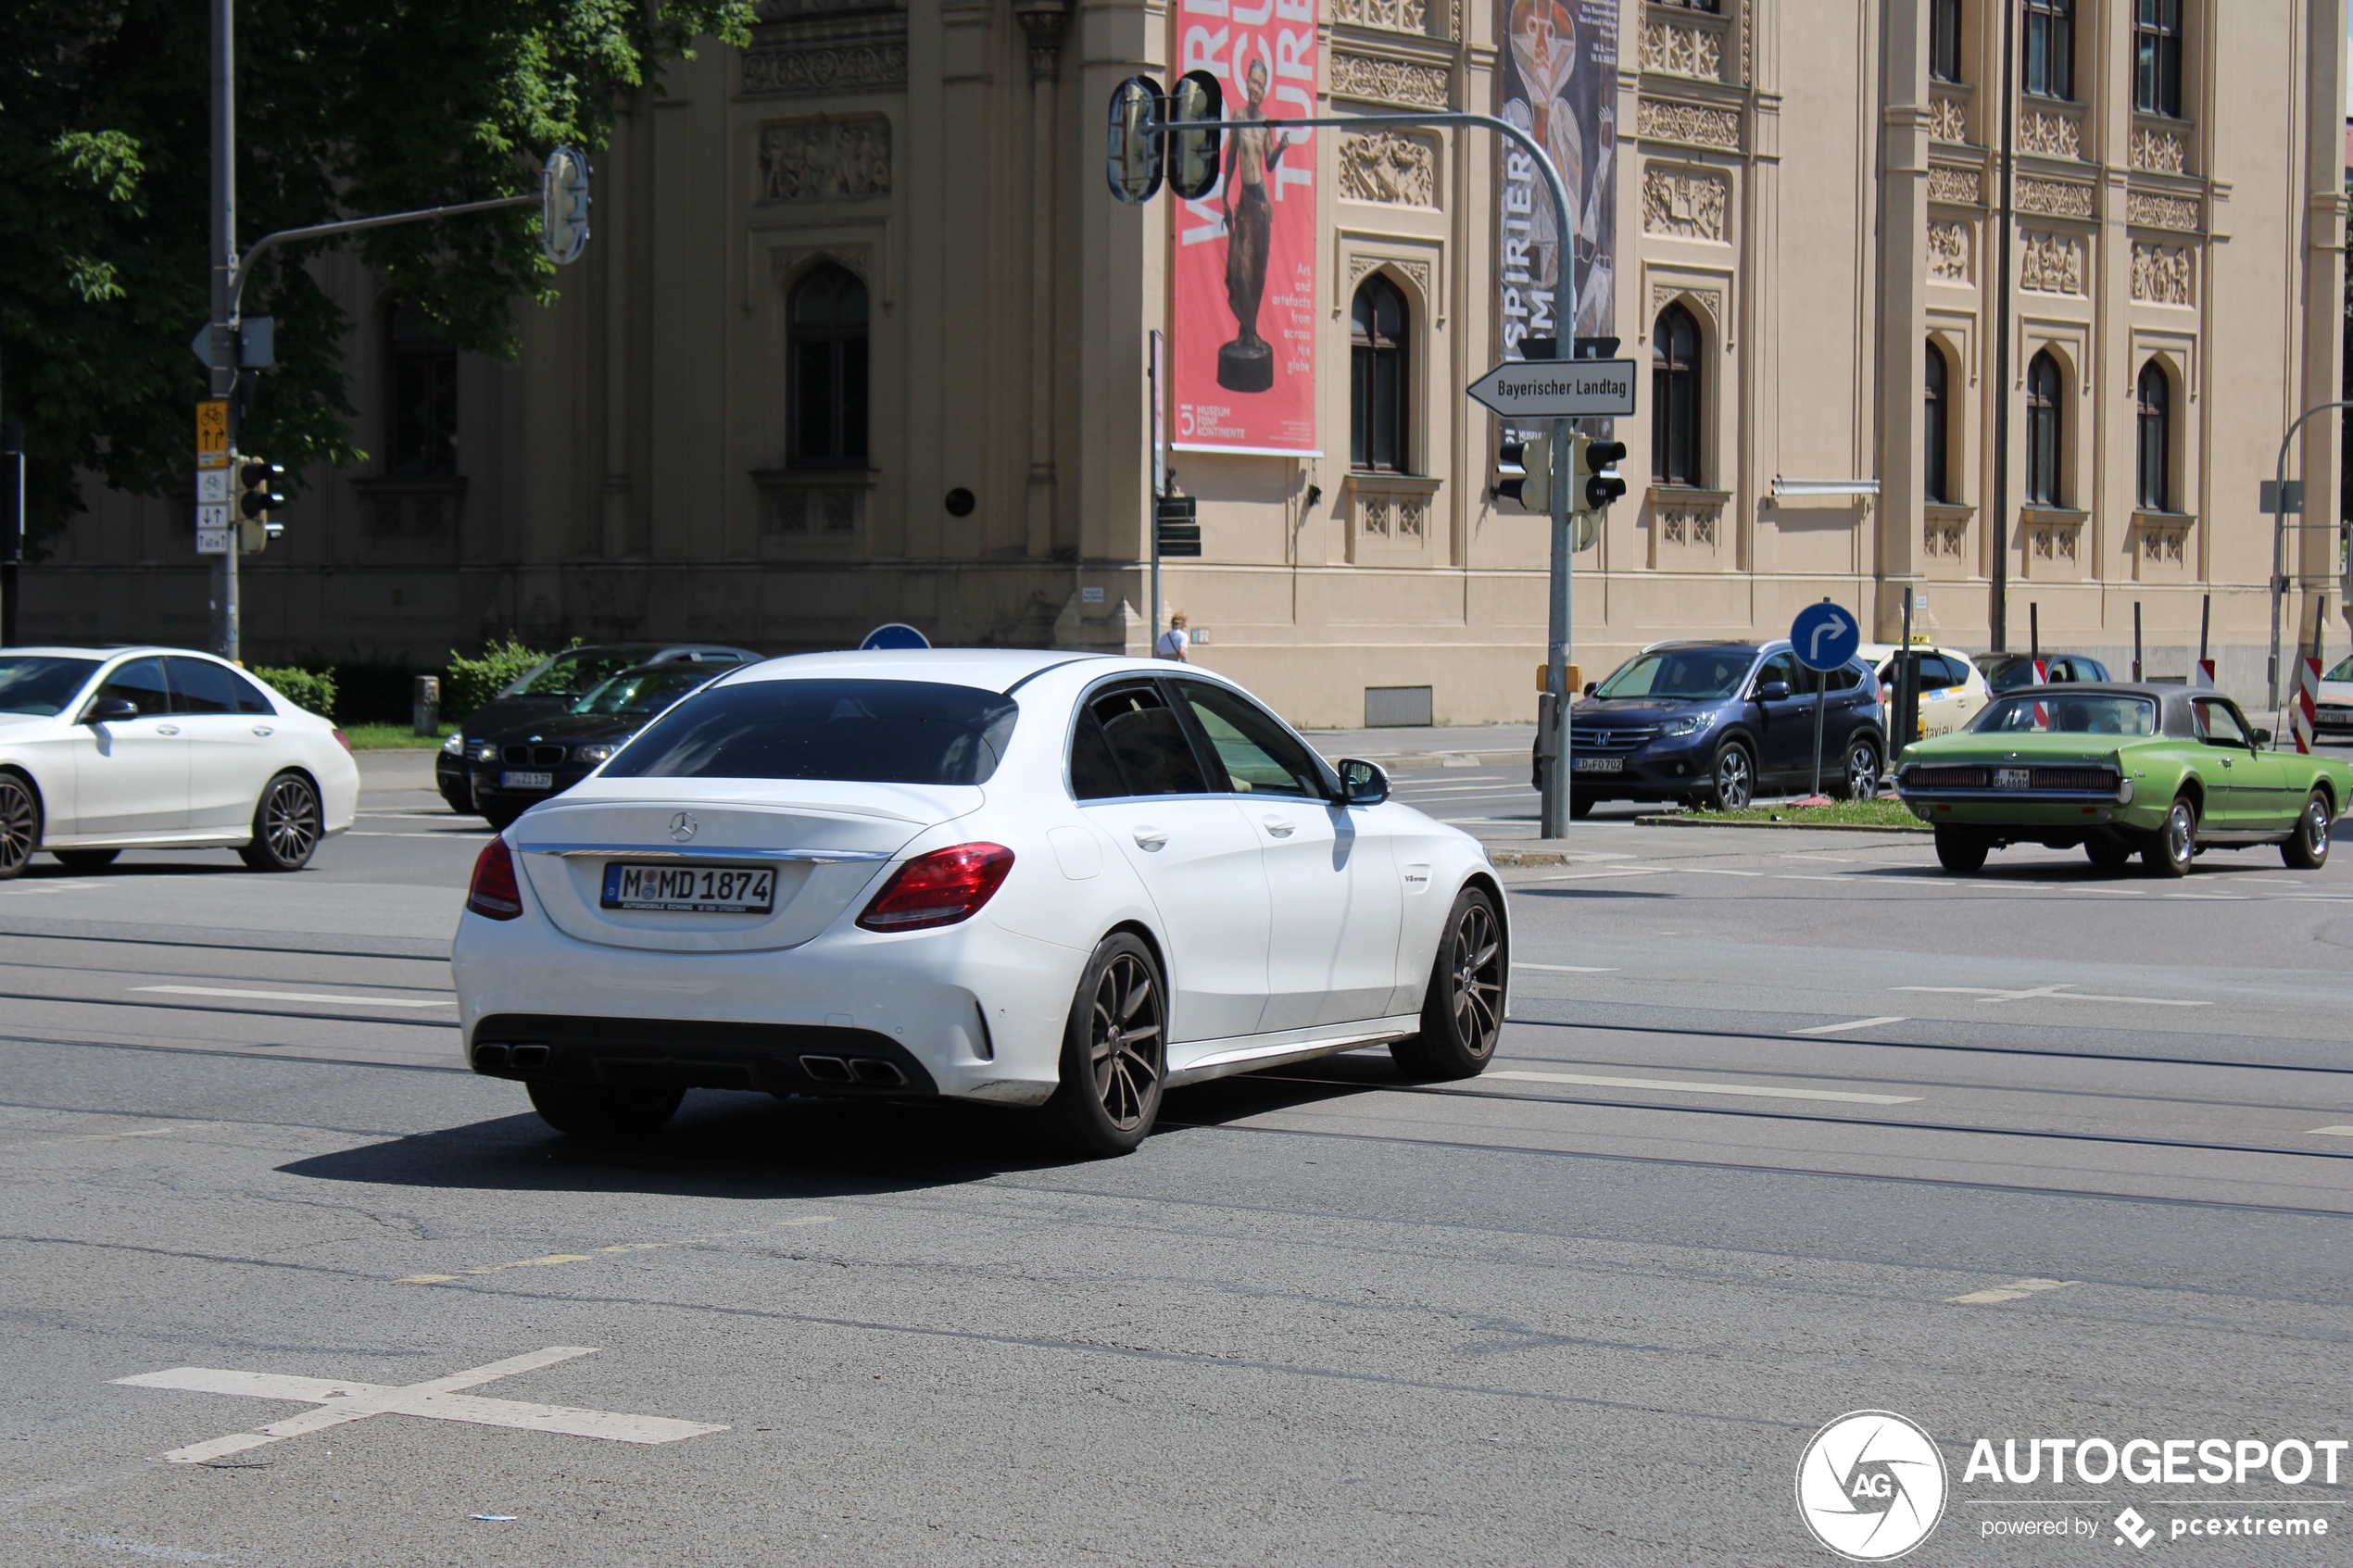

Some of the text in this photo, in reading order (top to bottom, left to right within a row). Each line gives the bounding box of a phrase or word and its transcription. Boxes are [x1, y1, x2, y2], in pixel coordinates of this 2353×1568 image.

[1297, 262, 1311, 276] Art
[1295, 280, 1311, 293] and
[1272, 293, 1311, 308] artefacts
[1290, 310, 1311, 324] from
[1283, 328, 1311, 341] across
[1297, 343, 1311, 357] the
[1287, 358, 1310, 375] globe
[1498, 378, 1626, 400] Bayerischer Landtag
[1197, 405, 1230, 417] MUSEUM
[1197, 426, 1245, 439] KONTINENTE
[1576, 759, 1588, 770] ED
[1605, 759, 1622, 770] 702
[623, 869, 769, 901] M MD 1874
